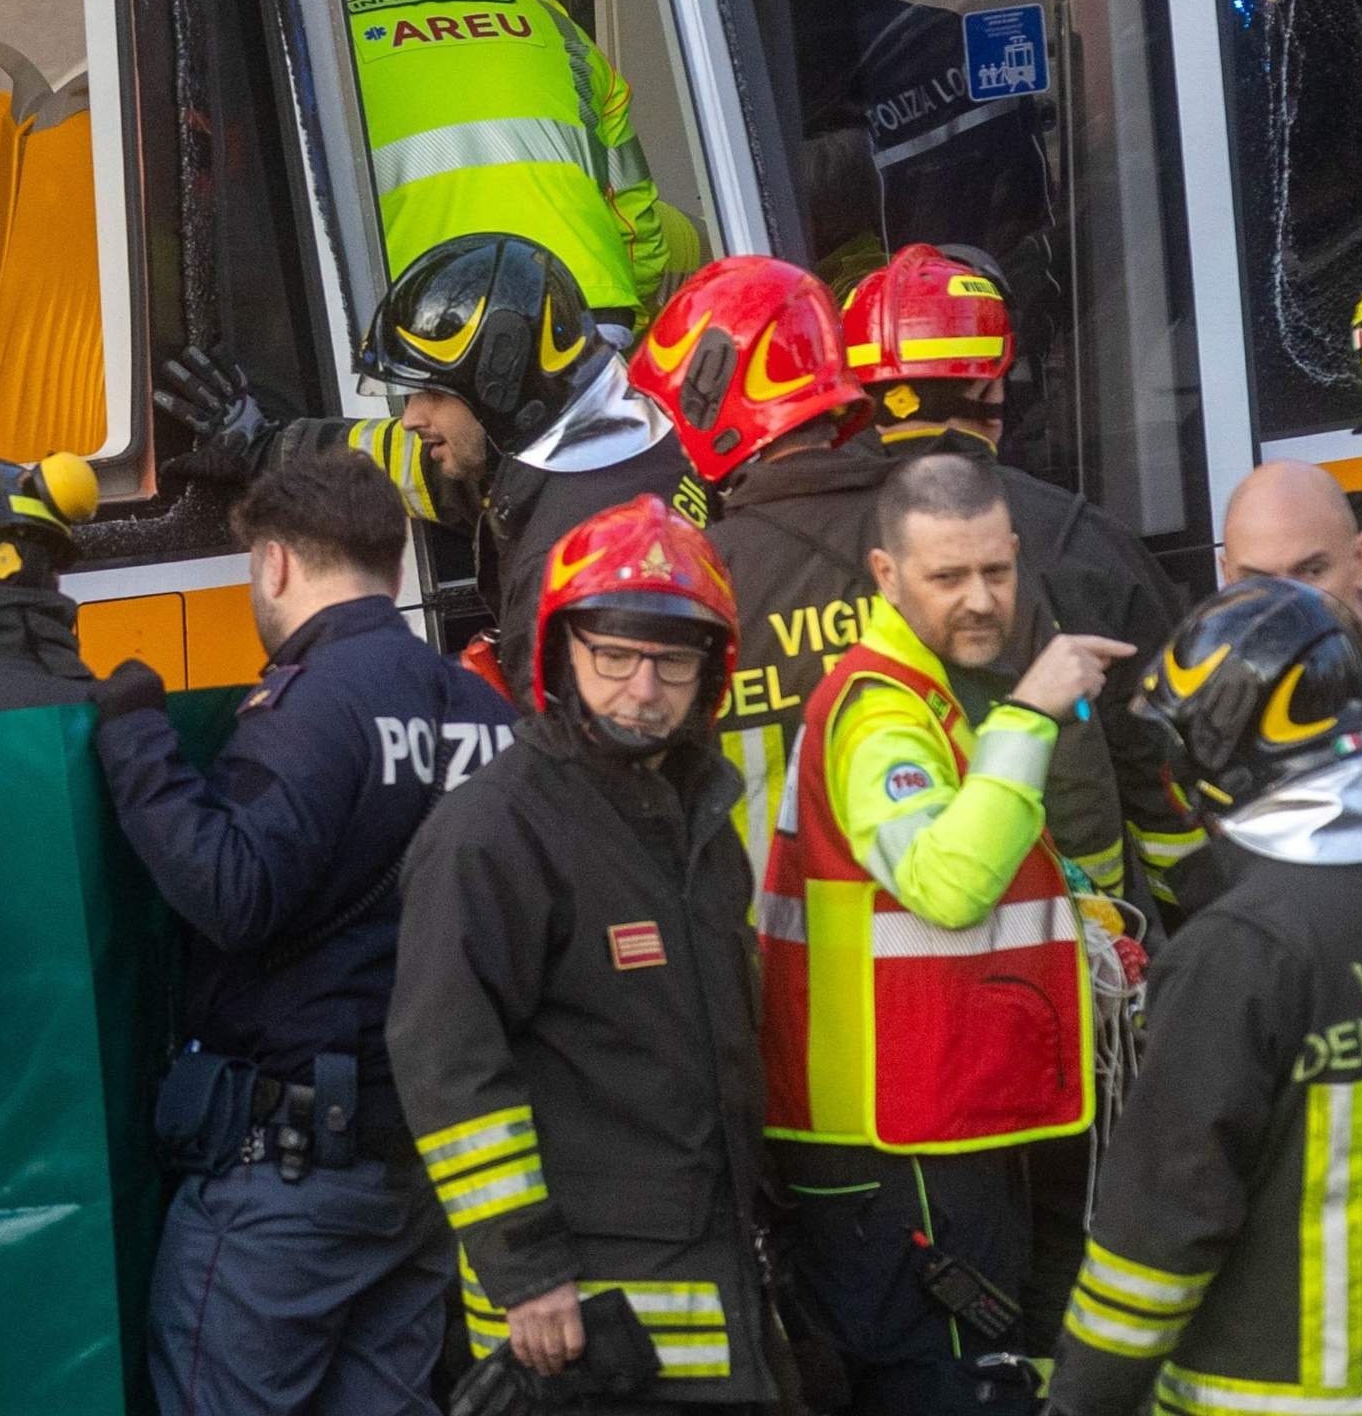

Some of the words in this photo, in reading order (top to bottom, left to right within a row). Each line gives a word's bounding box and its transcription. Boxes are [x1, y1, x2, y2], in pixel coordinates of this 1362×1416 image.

[393, 12, 534, 49] AREU
[768, 596, 872, 658] VIGI
[374, 716, 515, 792] POZI
